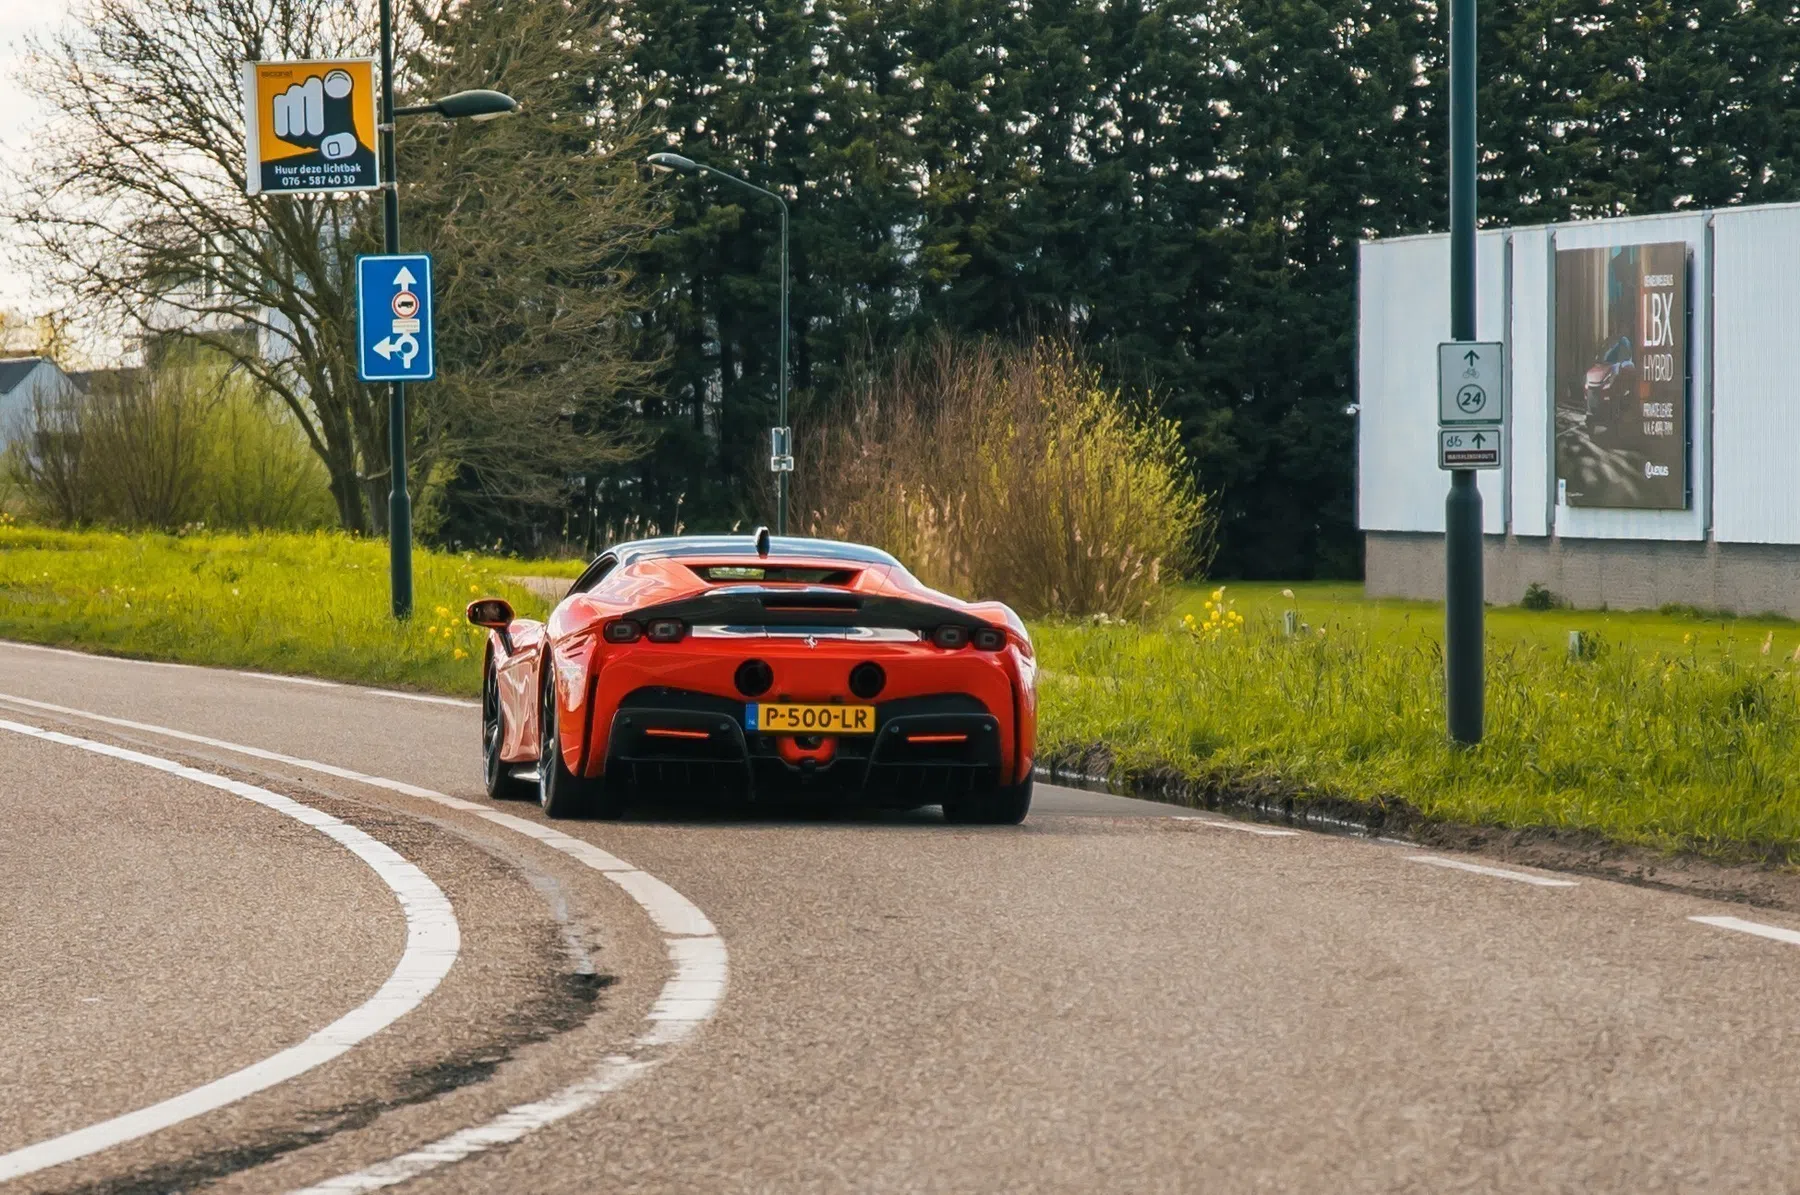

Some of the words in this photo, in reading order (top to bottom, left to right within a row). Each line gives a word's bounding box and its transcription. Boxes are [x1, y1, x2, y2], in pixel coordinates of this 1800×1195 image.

[274, 165, 298, 175] Huur
[299, 164, 322, 174] deze
[323, 163, 362, 174] lichtbak
[281, 176, 301, 186] 076
[308, 175, 326, 186] 587
[327, 175, 341, 185] 40
[342, 175, 356, 185] 30
[1643, 292, 1674, 347] LBX
[1643, 353, 1674, 382] HYBRID
[1461, 391, 1482, 406] 24
[765, 707, 868, 729] P-500-LR
